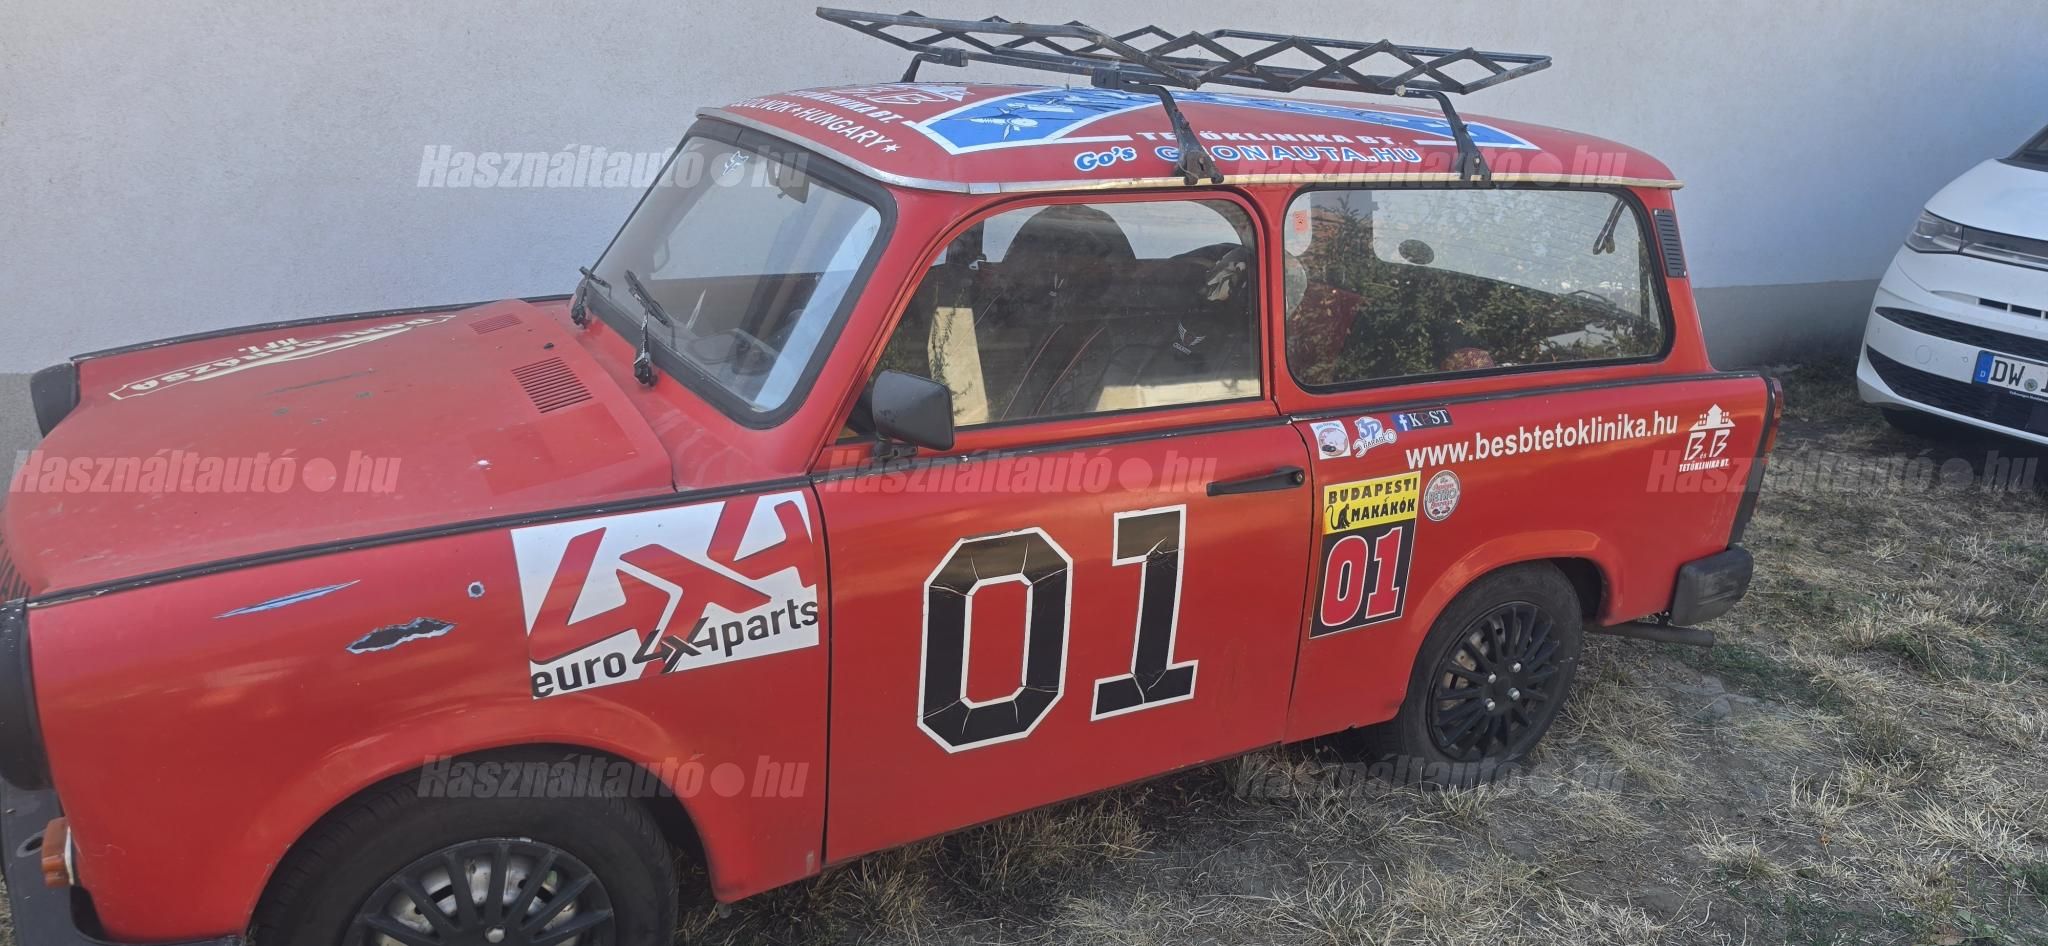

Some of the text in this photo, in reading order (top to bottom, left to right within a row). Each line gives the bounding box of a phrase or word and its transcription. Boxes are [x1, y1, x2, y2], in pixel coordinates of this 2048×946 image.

[799, 107, 893, 148] HUNGARY
[1136, 131, 1355, 143] TEŐKLINIKA
[1074, 145, 1423, 172] Go's GONAUTA.HU
[1991, 360, 2026, 386] DW
[1406, 410, 1678, 469] www.besbtetoklinika.hu
[1328, 477, 1418, 506] BUDAPESTI
[1351, 496, 1416, 523] MAKÁKÓK
[1320, 526, 1403, 627] 01
[917, 504, 1198, 754] 01
